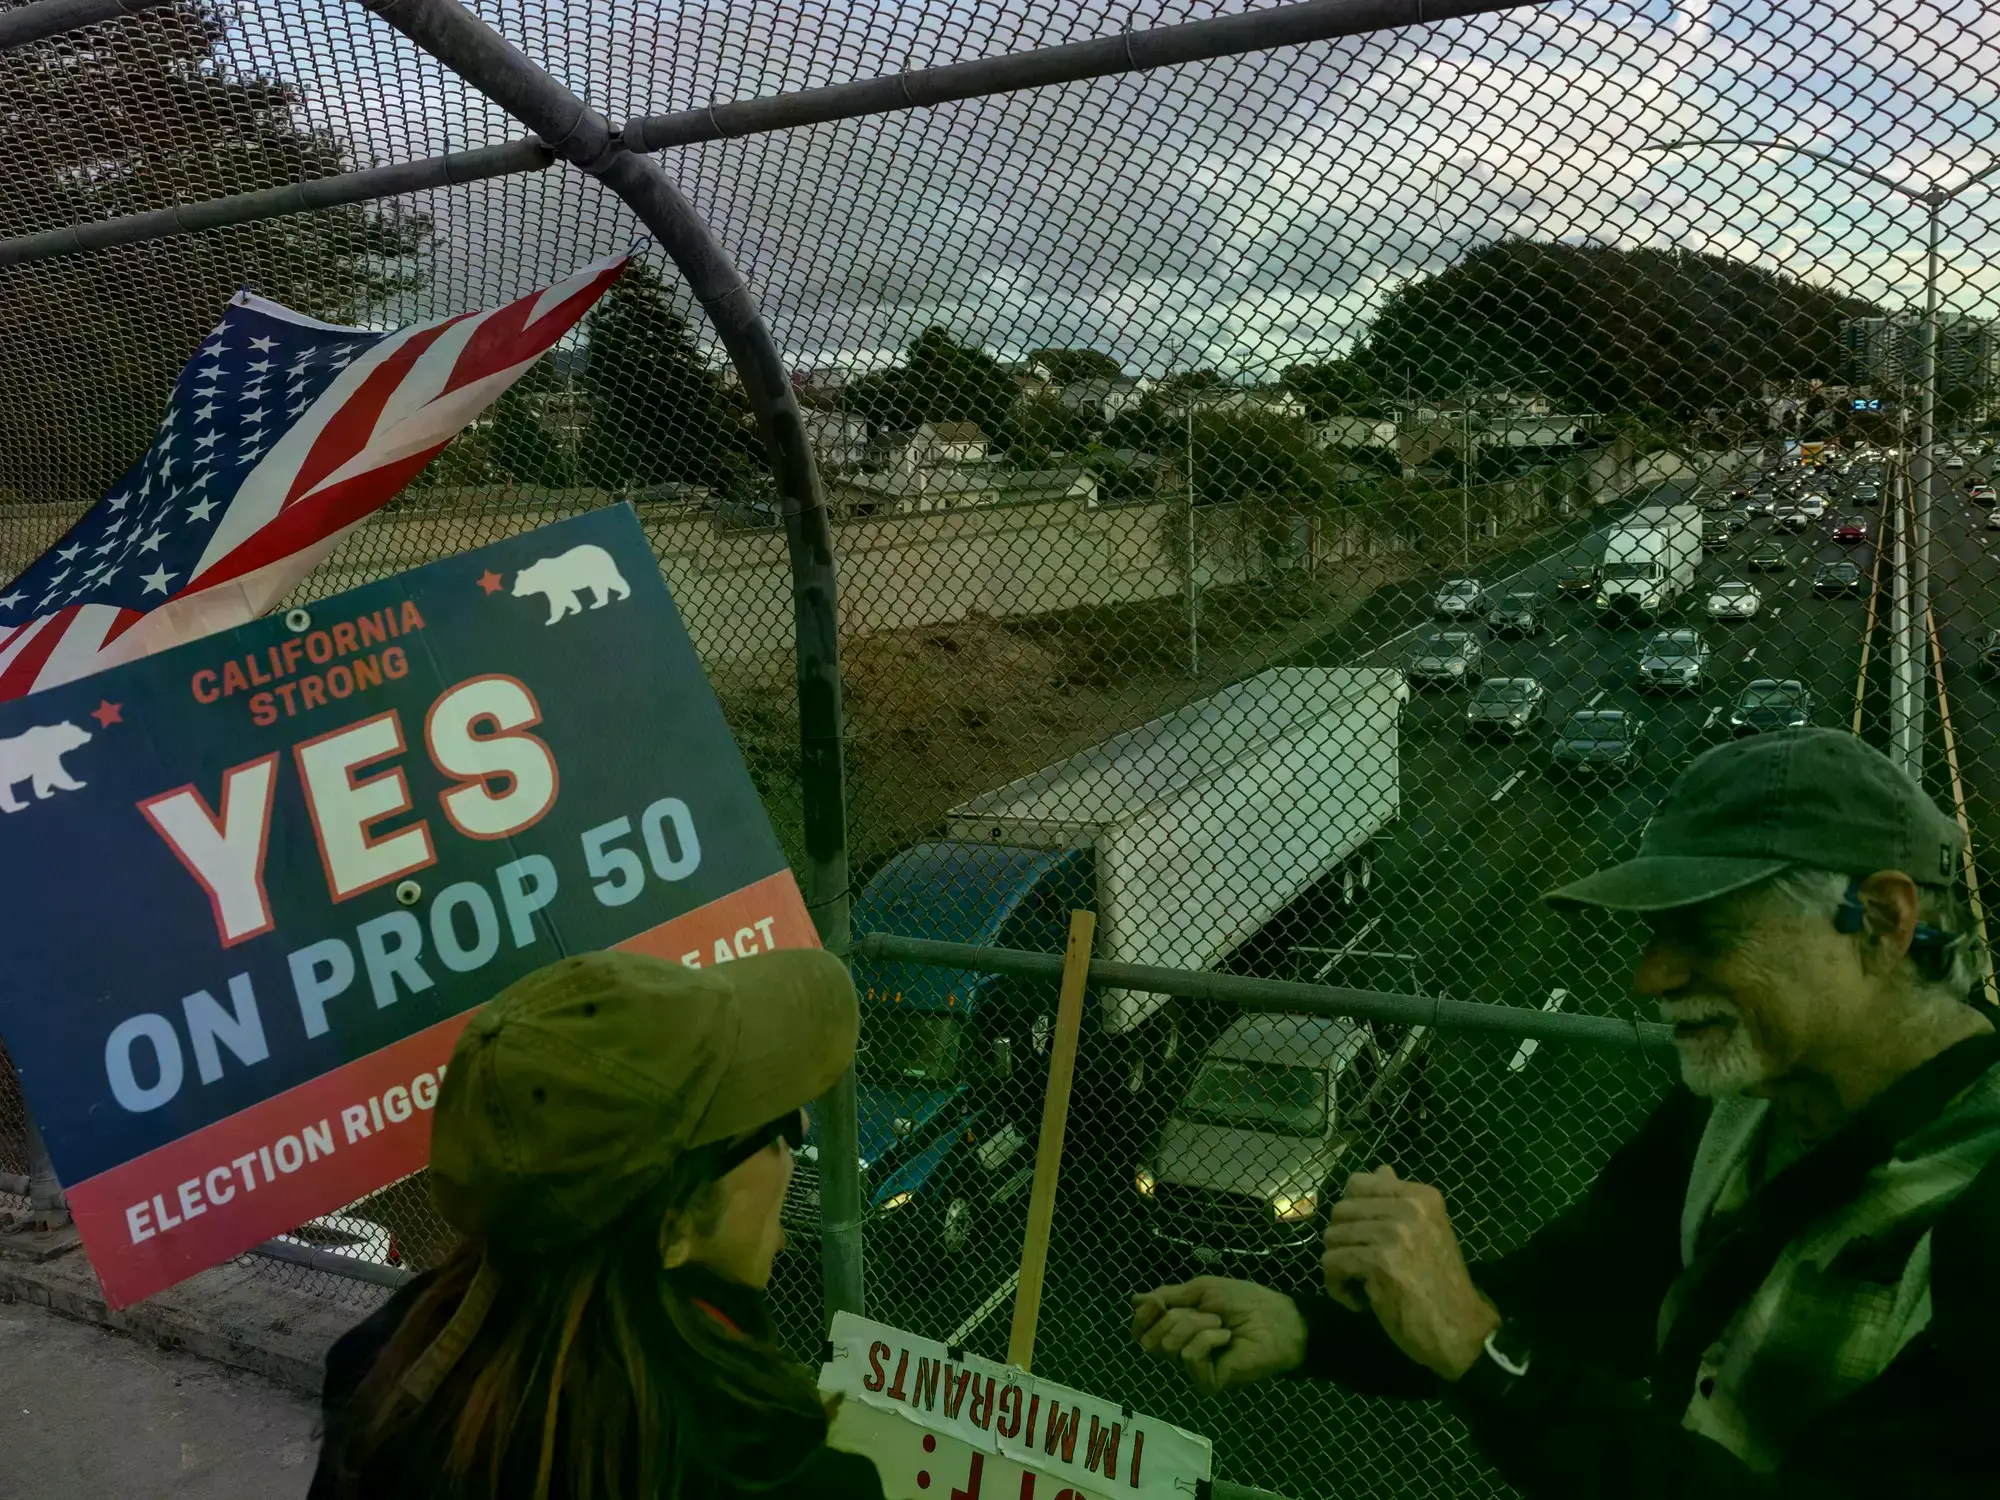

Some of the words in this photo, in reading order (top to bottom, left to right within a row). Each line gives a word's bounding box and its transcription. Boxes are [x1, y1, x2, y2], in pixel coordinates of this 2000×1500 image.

[191, 600, 426, 704] CALIFORNIA
[249, 646, 409, 726] STRONG
[135, 673, 560, 950] YES
[104, 972, 271, 1113] ON
[287, 854, 559, 1040] PROP
[581, 798, 702, 908] 50
[125, 1112, 335, 1246] ELECTION
[341, 1064, 447, 1145] RIGG
[714, 916, 775, 964] ACT
[863, 1340, 1145, 1489] IMMIGRANTS
